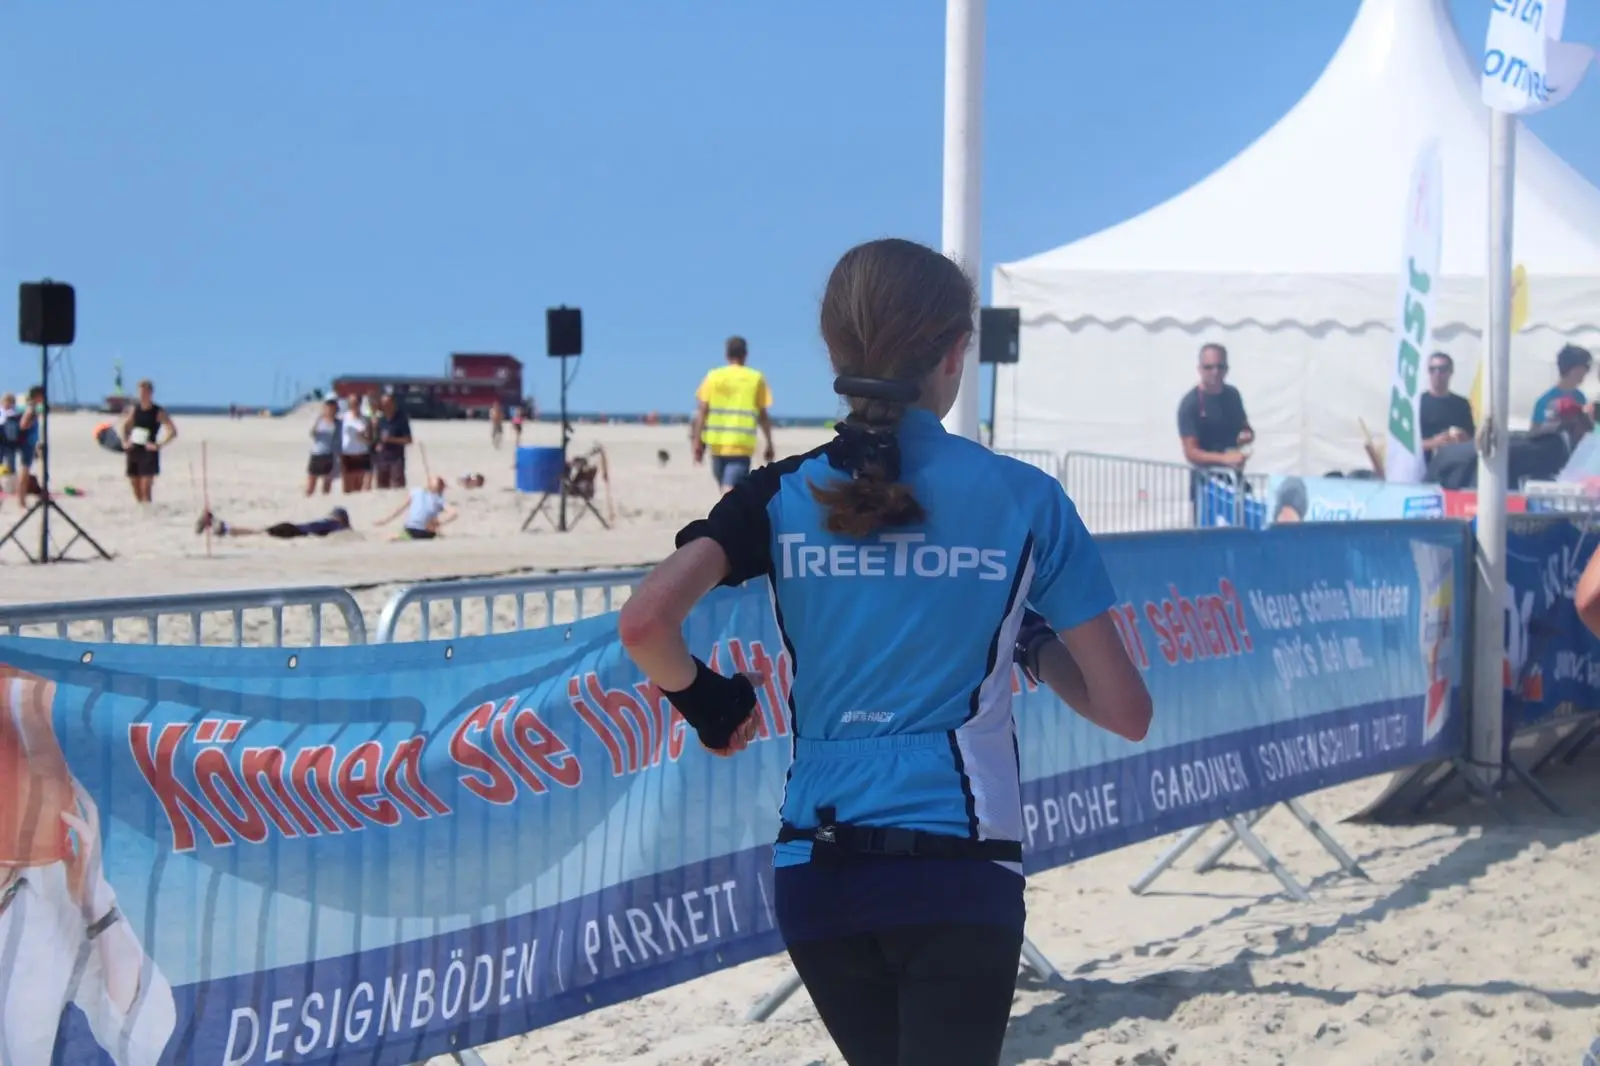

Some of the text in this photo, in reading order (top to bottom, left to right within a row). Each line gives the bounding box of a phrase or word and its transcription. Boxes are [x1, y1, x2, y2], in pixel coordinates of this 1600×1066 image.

[128, 719, 451, 853] Können
[449, 698, 581, 806] Sie
[1144, 577, 1253, 667] sehen?
[222, 940, 538, 1066] DESIGNBÖDEN
[584, 880, 740, 974] PARKETT
[1021, 782, 1120, 851] PPICHE
[1150, 749, 1249, 812] GARDINEN
